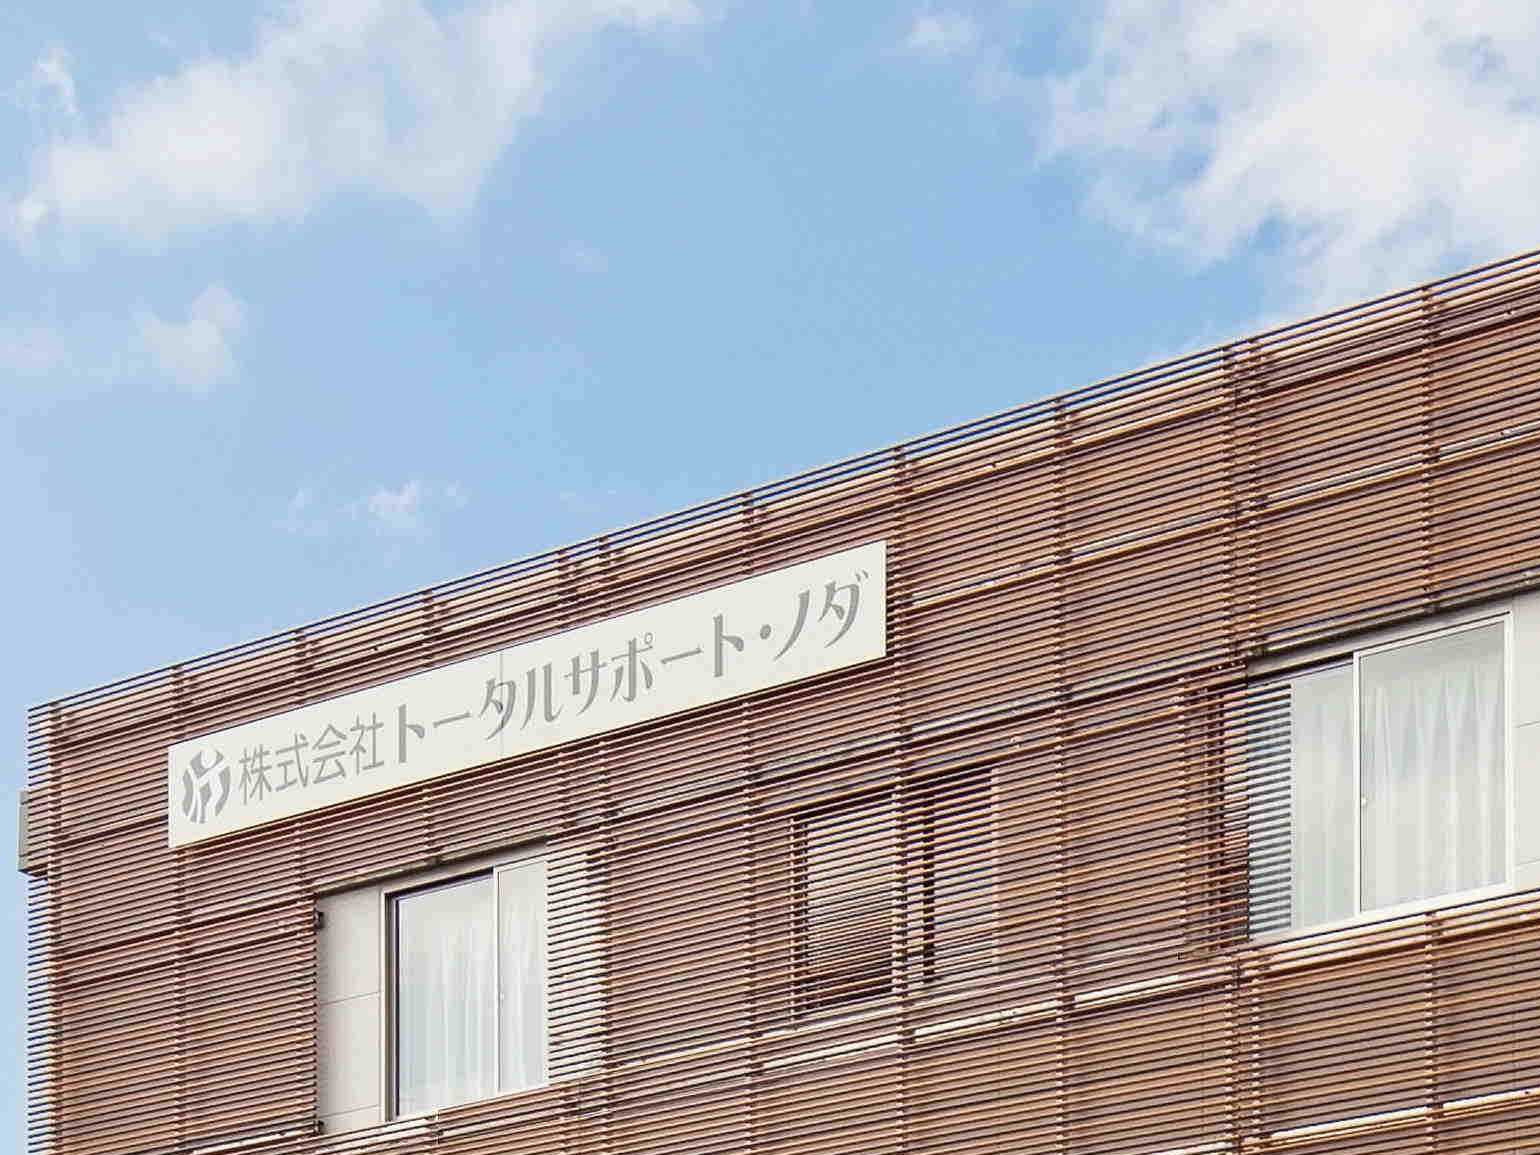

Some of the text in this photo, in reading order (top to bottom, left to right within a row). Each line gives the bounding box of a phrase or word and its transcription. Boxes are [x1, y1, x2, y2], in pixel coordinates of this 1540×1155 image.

[240, 570, 869, 806] 株式会社トータルサポート・ノダ
